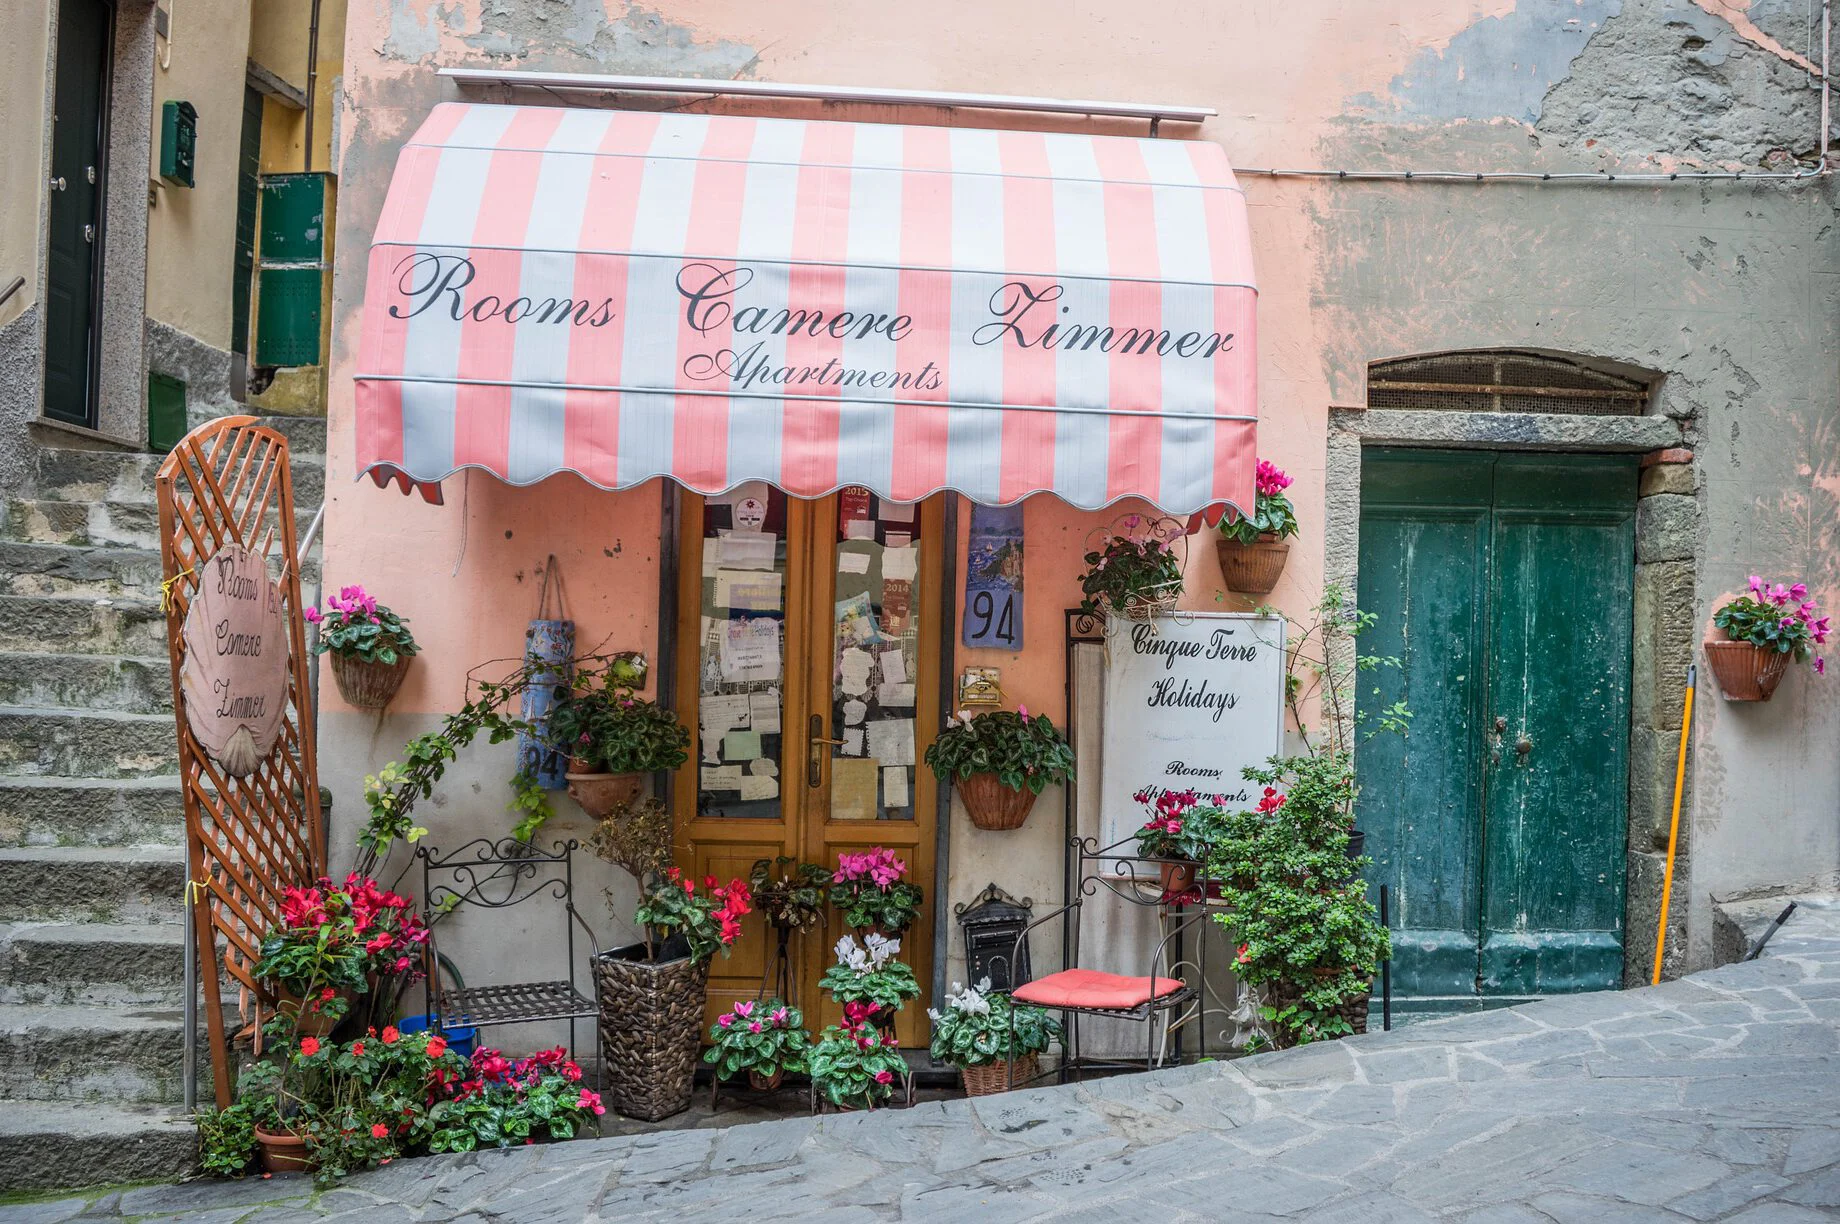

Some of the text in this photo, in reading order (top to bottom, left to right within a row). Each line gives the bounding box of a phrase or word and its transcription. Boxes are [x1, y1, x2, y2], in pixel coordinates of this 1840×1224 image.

[389, 252, 1236, 359] Rooms Camere Zimmer
[683, 340, 943, 390] Apartments
[217, 555, 258, 600] Rooms
[971, 590, 1016, 645] 94
[1130, 623, 1258, 670] Cinque Terre
[213, 678, 266, 719] Zimmer
[1147, 676, 1241, 723] Holidays
[525, 746, 559, 780] 94
